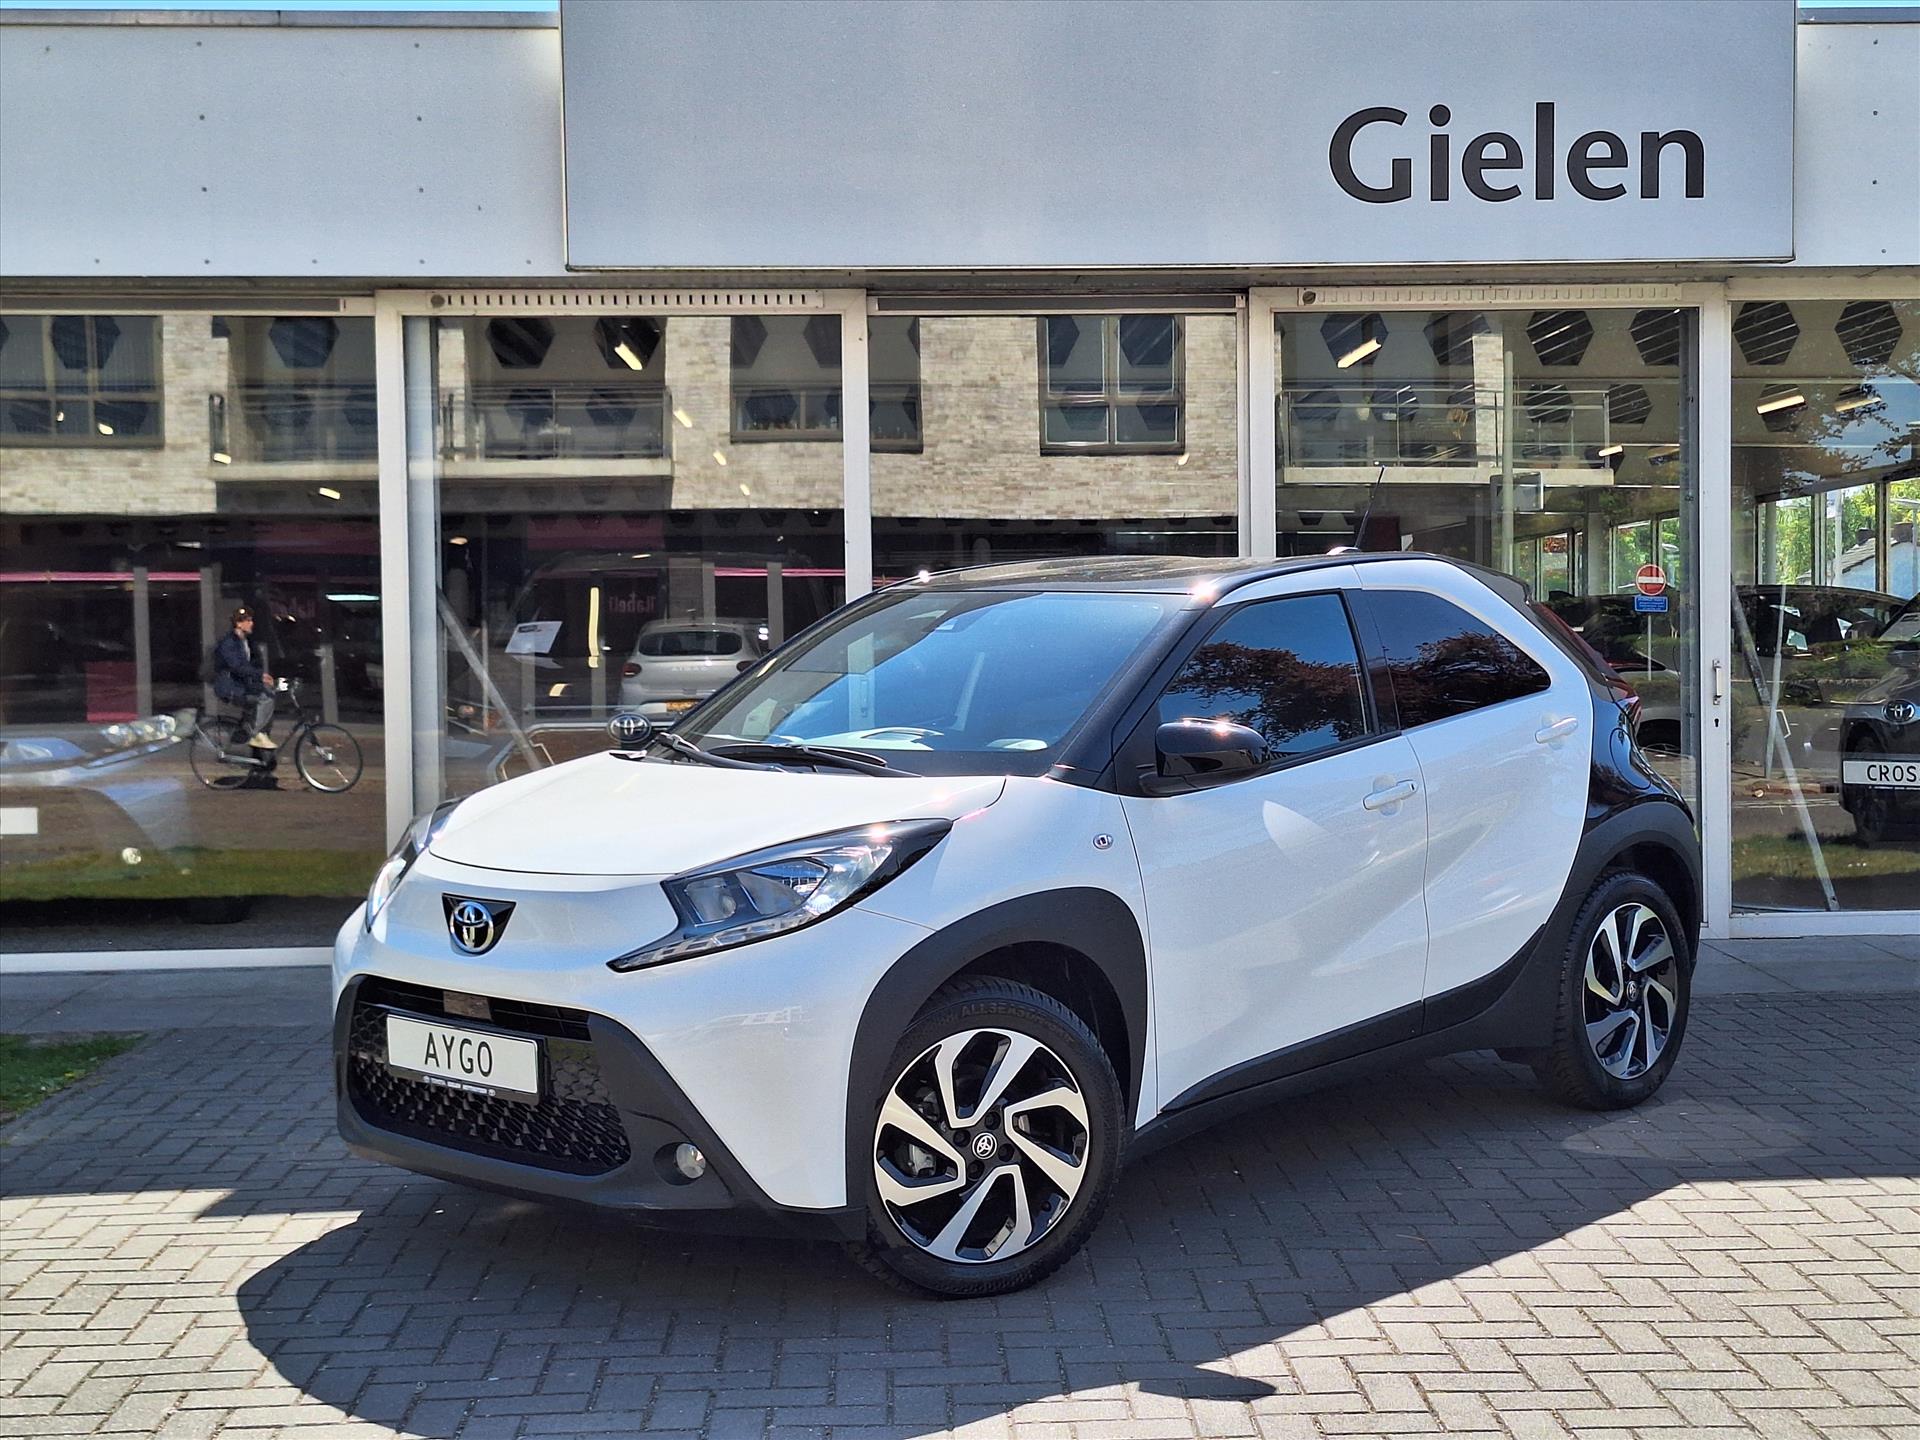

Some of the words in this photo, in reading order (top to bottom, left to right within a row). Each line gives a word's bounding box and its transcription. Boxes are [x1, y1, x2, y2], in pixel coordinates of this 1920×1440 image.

[1329, 101, 1704, 203] Gielen
[1867, 764, 1920, 782] CROS
[424, 1031, 493, 1078] AYGO
